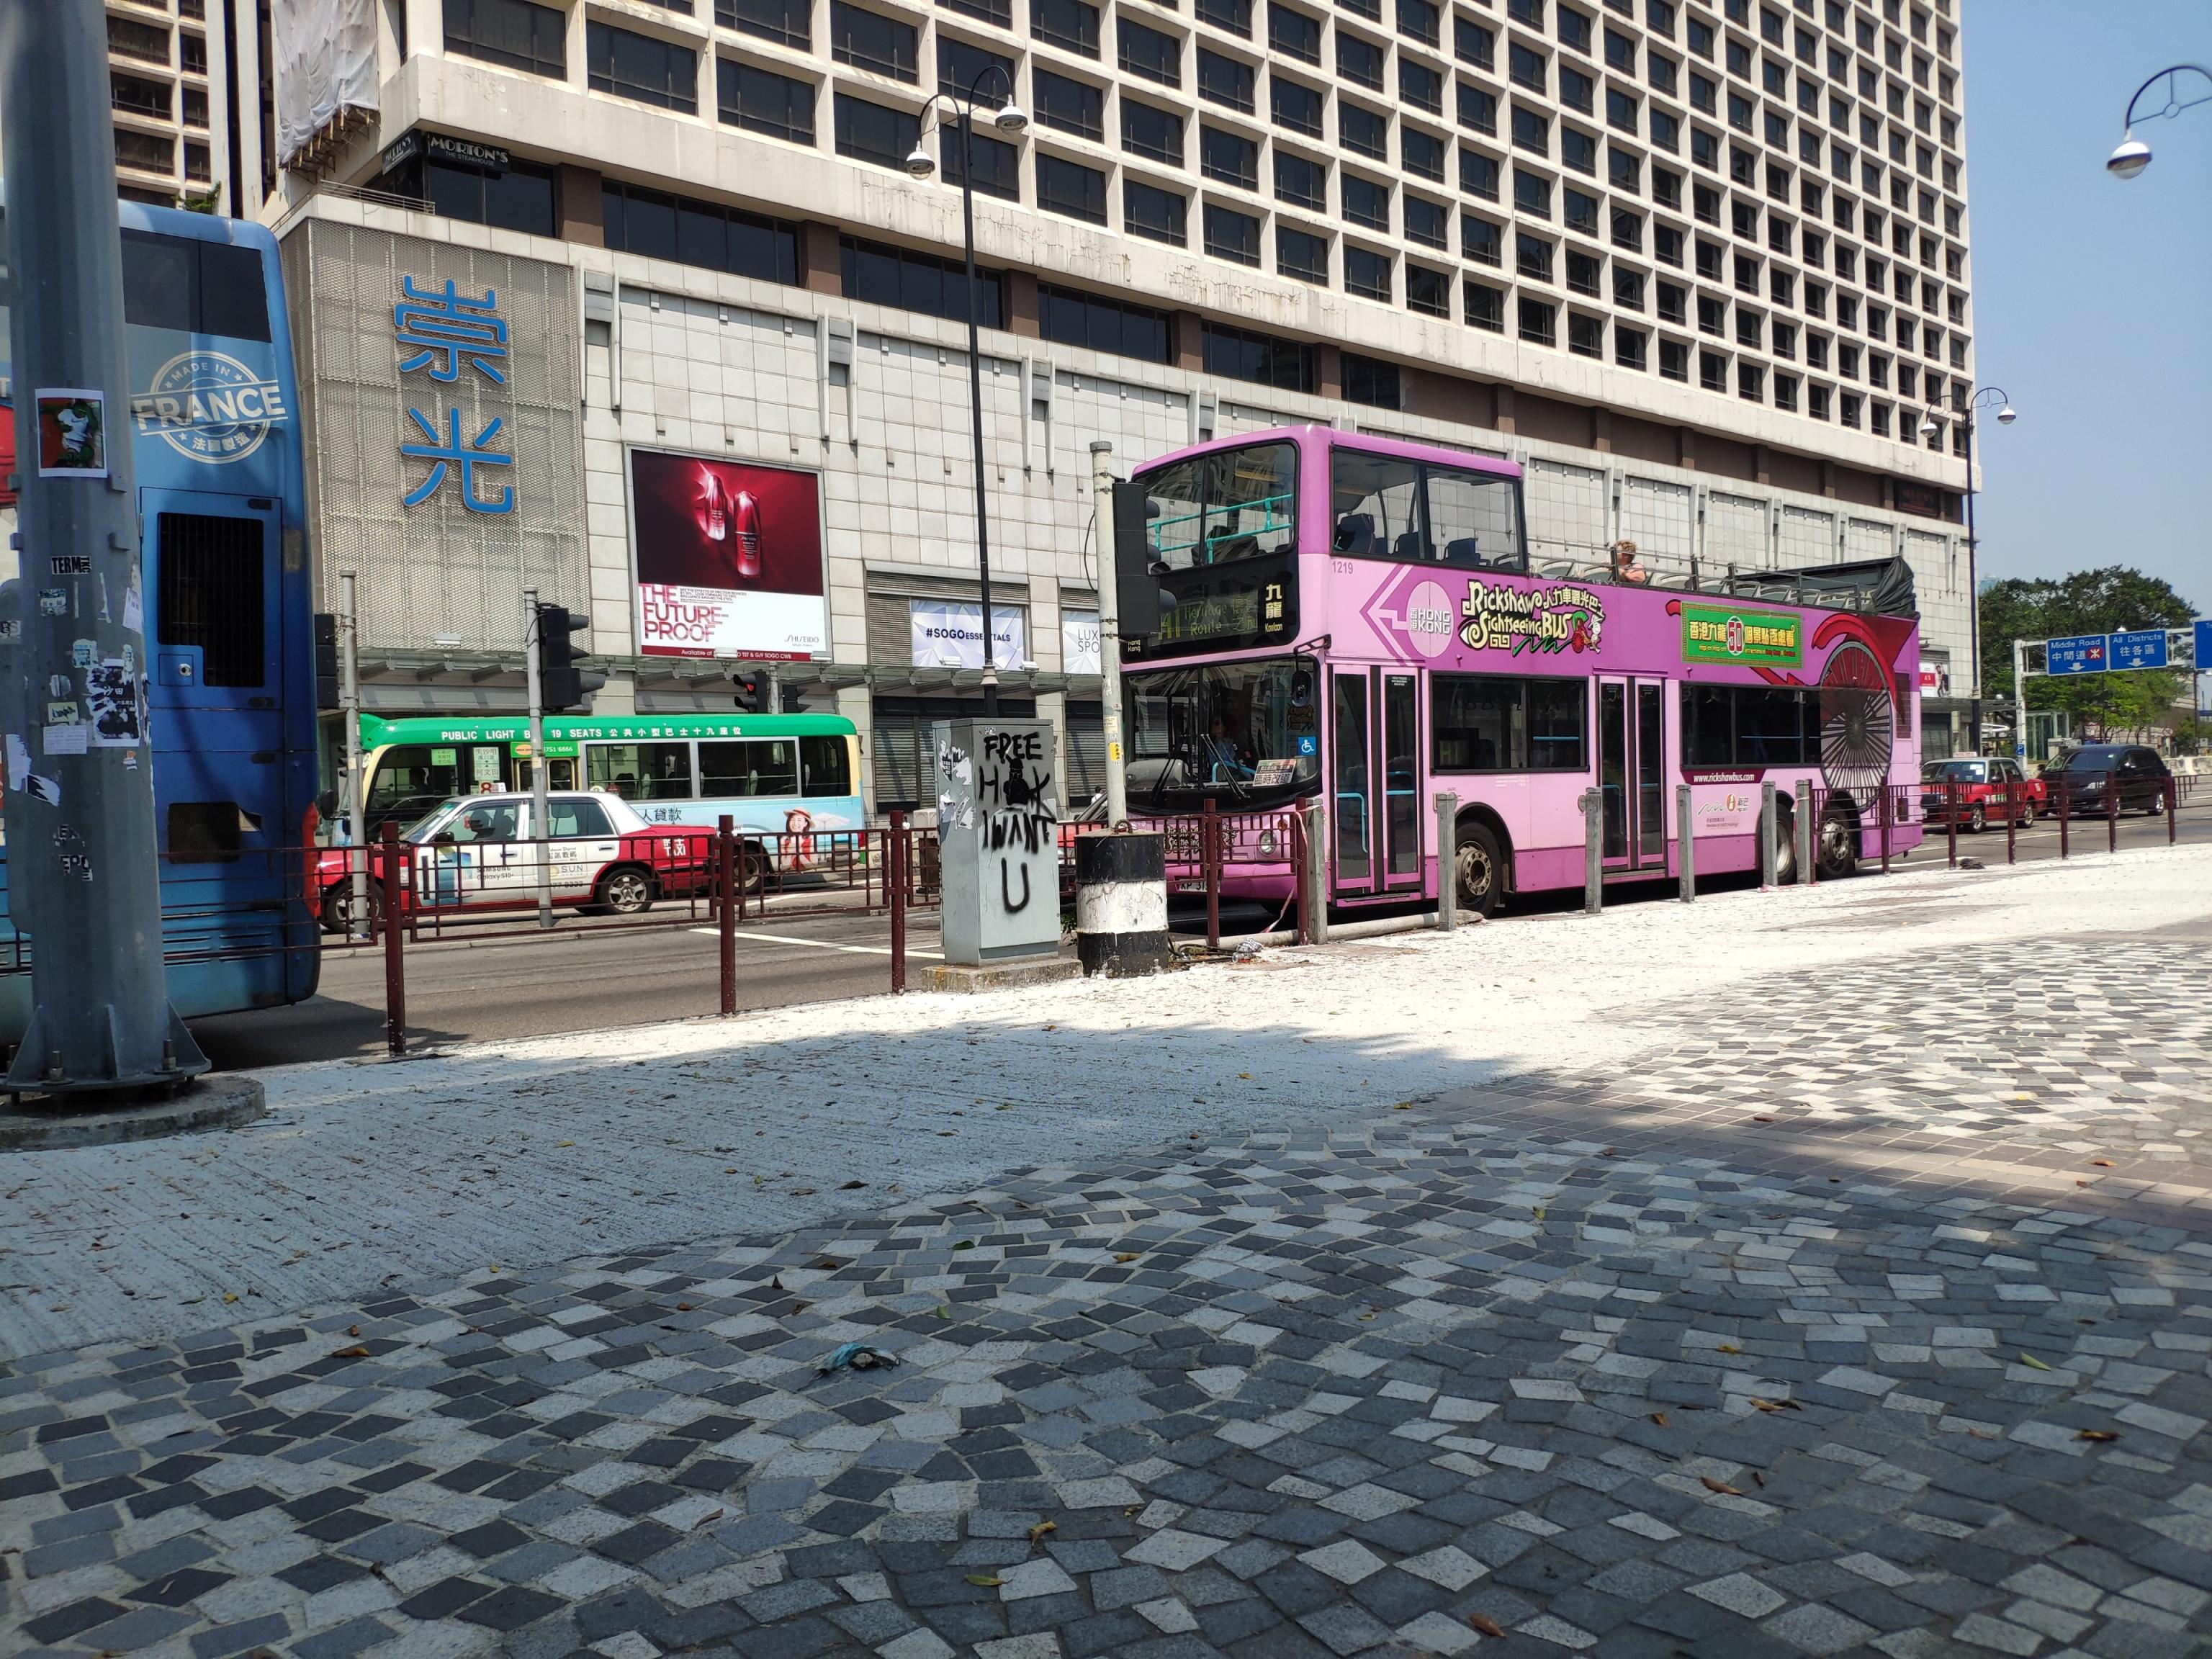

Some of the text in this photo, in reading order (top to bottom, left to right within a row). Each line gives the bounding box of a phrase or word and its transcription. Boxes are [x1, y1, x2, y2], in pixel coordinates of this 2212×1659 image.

[431, 136, 508, 163] MORTON'S
[457, 153, 495, 166] STEAKHOUSE
[171, 362, 231, 381] MADE IN
[394, 275, 514, 514] 崇光
[132, 385, 286, 431] FRANCE
[52, 557, 81, 574] TERM
[1332, 561, 1354, 575] 1219
[639, 583, 678, 603] THE
[1266, 584, 1282, 619] 九龍
[1462, 580, 1543, 616] Rickshaw
[644, 603, 729, 625] FUTURE-
[1410, 608, 1419, 631] 香港
[1419, 608, 1451, 622] HONG
[645, 621, 716, 642] PROOF
[1191, 621, 1222, 636] Route
[1419, 621, 1451, 634] KONG
[1467, 611, 1573, 649] Sightseeing BUS
[1728, 621, 1743, 652] 50
[2051, 640, 2075, 649] Middle
[2128, 634, 2162, 643] Districts
[2052, 650, 2086, 662] 中間道
[2120, 644, 2155, 657] 往各區
[441, 731, 478, 742] PUBLIC
[486, 729, 515, 739] LIGHT
[552, 729, 561, 738] 19
[570, 728, 602, 737] SEATS
[609, 727, 742, 737] 公共小型巴士十九座位
[984, 732, 1043, 763] FREE
[1693, 772, 1754, 783] www.rickshawbus.com
[1002, 858, 1030, 914] U
